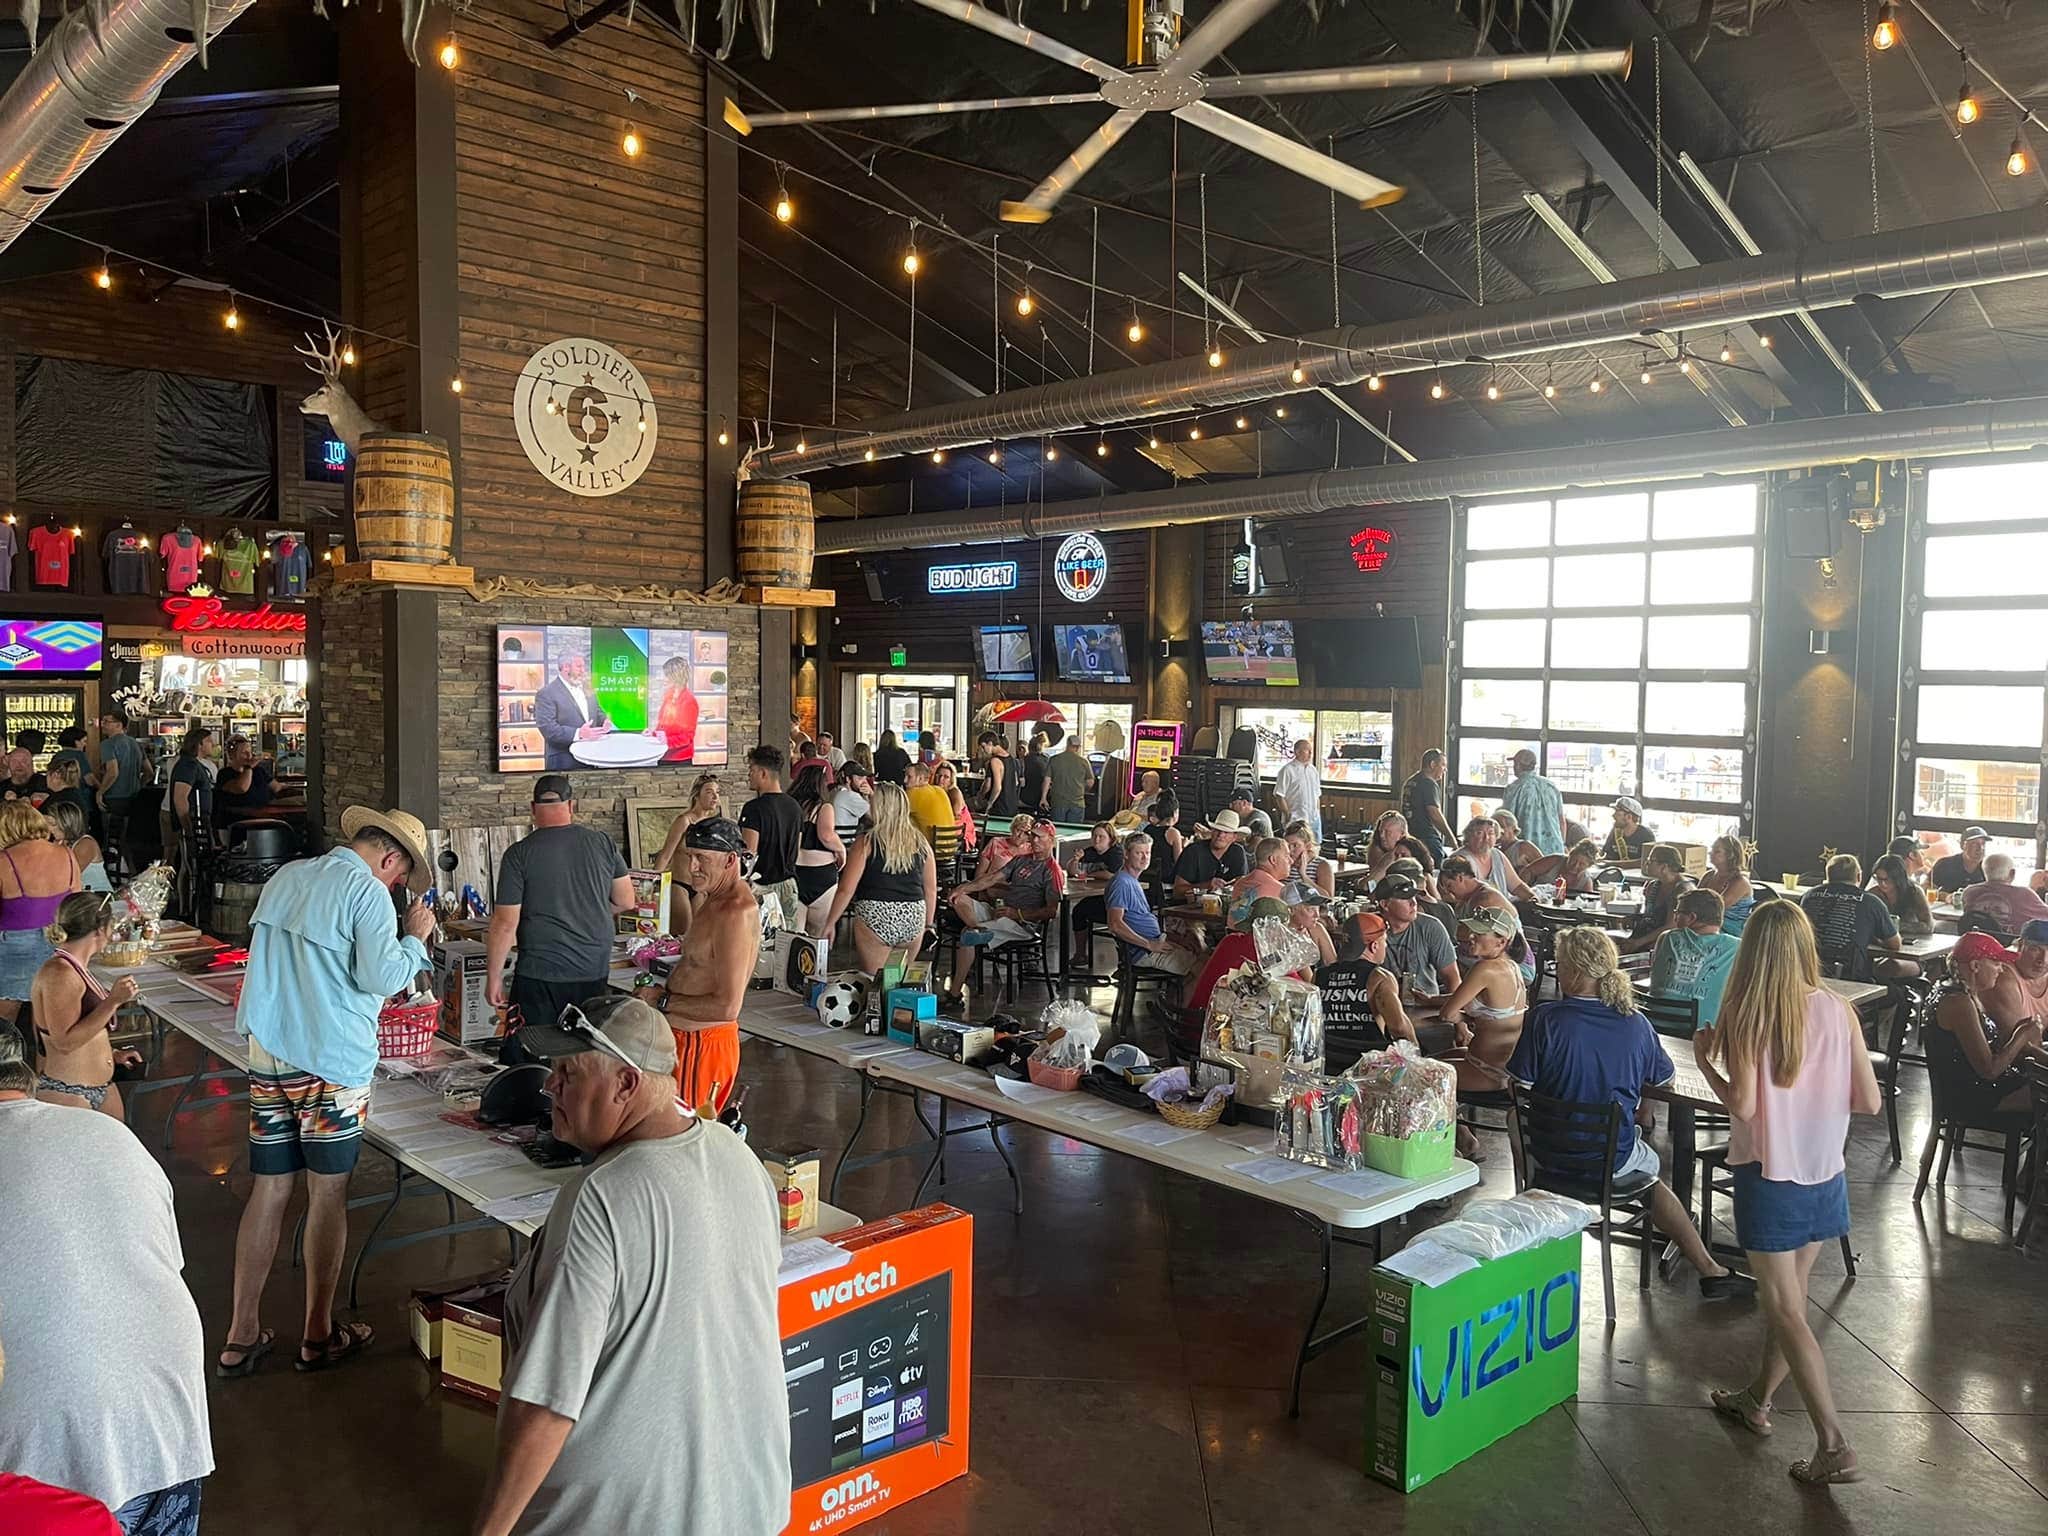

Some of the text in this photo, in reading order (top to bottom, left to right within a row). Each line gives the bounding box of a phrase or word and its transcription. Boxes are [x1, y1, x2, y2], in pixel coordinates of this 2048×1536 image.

[540, 346, 634, 391] SOLDIER
[567, 386, 609, 444] 6
[550, 455, 627, 489] VALLEY
[1062, 561, 1080, 570] LIKE
[1081, 559, 1104, 569] BEER
[931, 566, 1013, 588] BUD LIGHT
[191, 639, 291, 655] Cottonwood
[600, 676, 639, 686] SMART
[811, 1261, 897, 1311] watch
[1375, 1288, 1406, 1308] VIZIO
[801, 1340, 810, 1351] TV
[1413, 1270, 1579, 1418] VIZIO
[835, 1391, 859, 1406] NETFLIX
[902, 1396, 922, 1413] HBO
[899, 1406, 923, 1425] max
[821, 1471, 880, 1511] onn.
[809, 1487, 891, 1532] 4K UHD Smart TV
